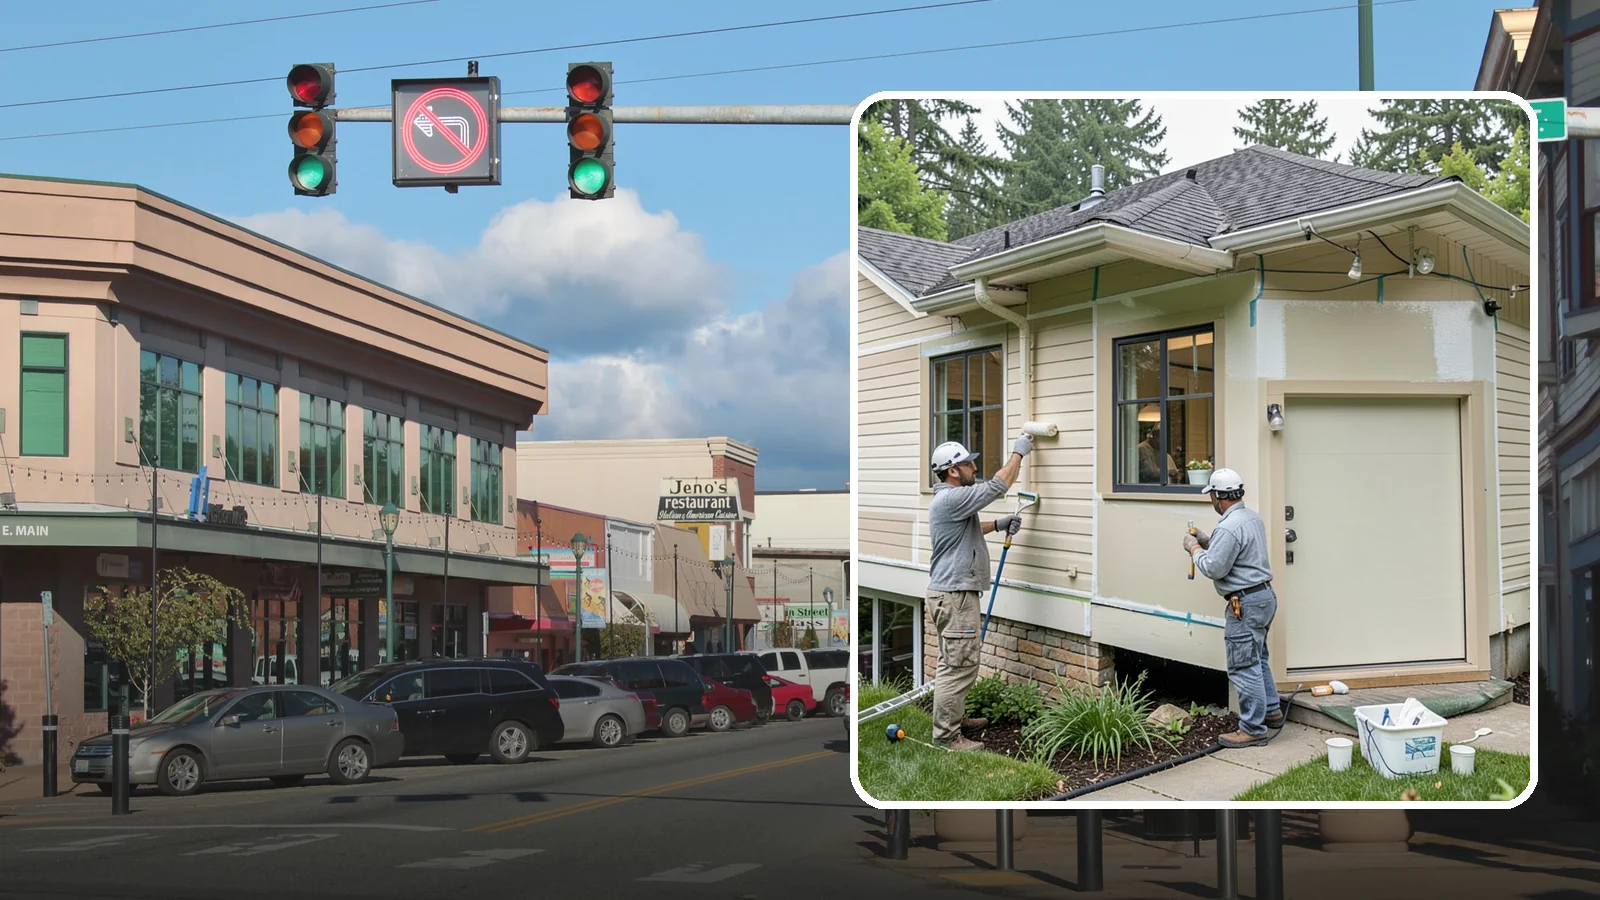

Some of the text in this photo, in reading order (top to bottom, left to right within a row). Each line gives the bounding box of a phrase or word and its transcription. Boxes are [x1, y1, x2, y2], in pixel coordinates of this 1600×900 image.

[670, 480, 727, 494] Jeno's
[665, 496, 731, 509] restaurant
[658, 509, 682, 520] Italian
[686, 509, 714, 519] American
[715, 509, 737, 519] Cuisine
[2, 525, 49, 536] E. MAIN
[797, 607, 828, 616] Street
